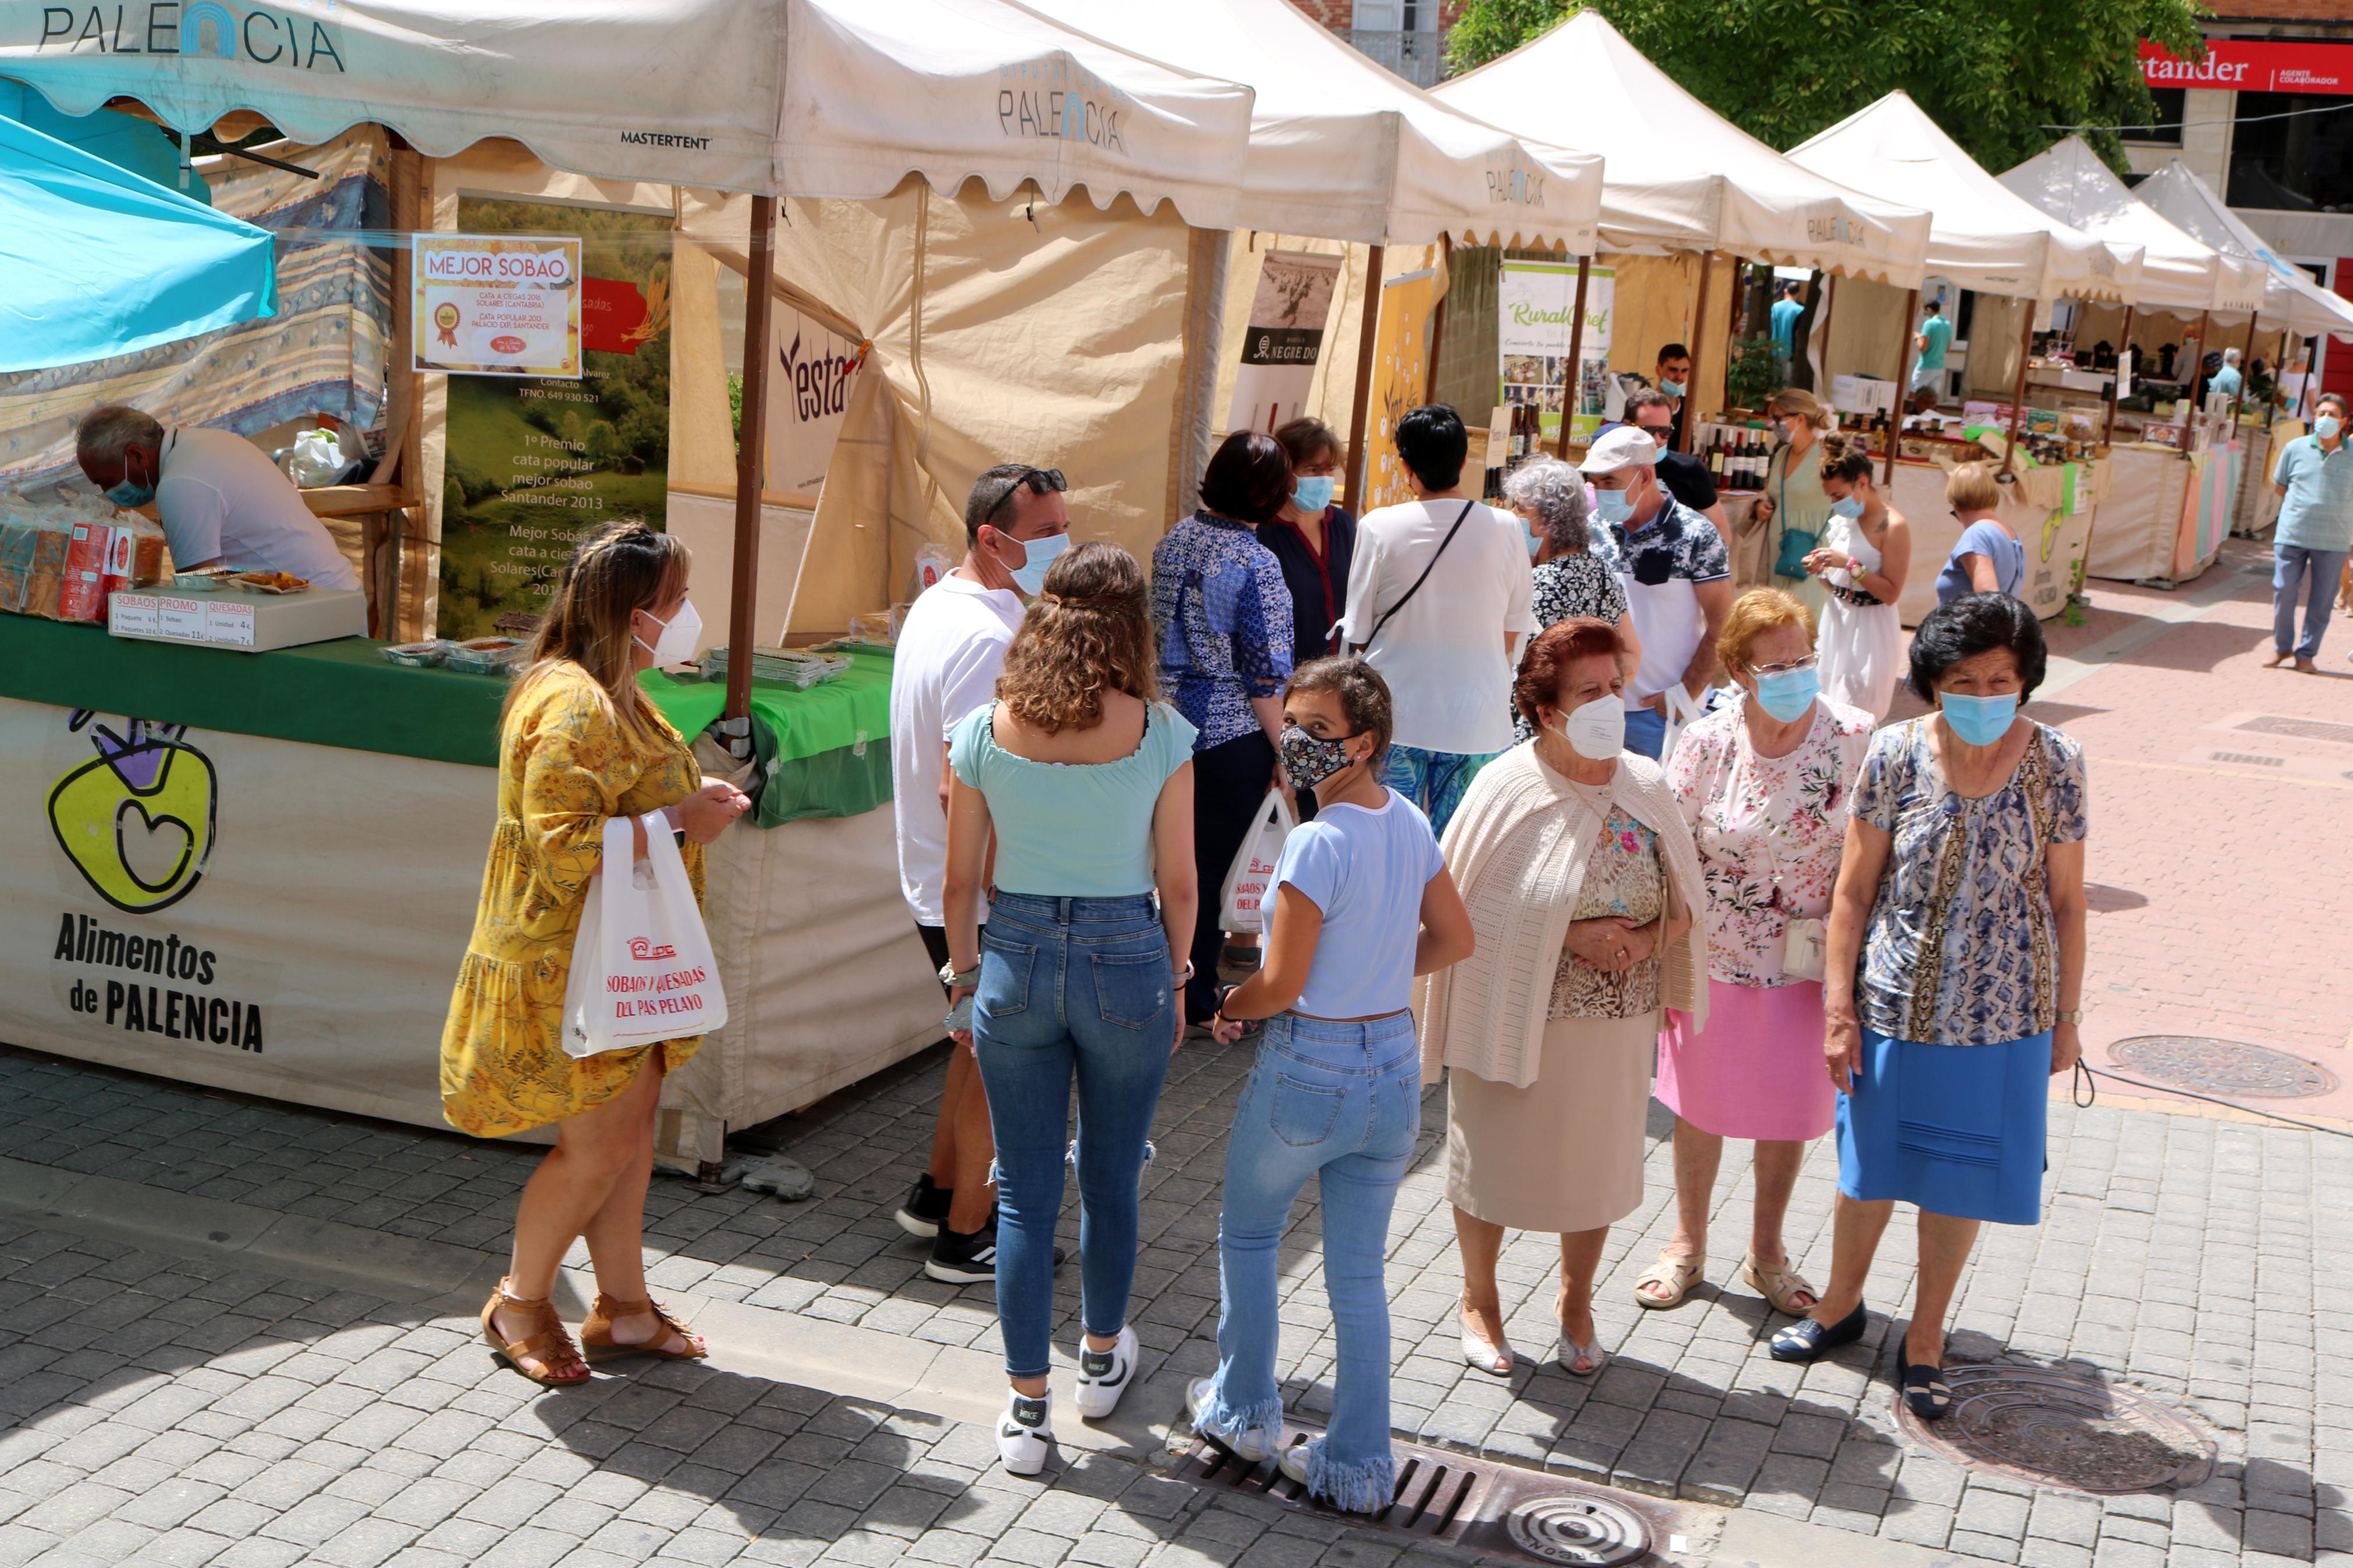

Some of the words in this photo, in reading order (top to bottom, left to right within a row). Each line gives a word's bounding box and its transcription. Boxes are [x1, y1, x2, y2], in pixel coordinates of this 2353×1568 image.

[2279, 76, 2338, 85] COLABORADOR
[999, 90, 1122, 151] PALENCIA
[621, 131, 710, 150] MASTERTENT
[430, 256, 492, 276] MEJOR
[498, 258, 565, 278] SOBAO
[505, 300, 544, 309] (CANTABRIA)
[541, 378, 580, 389] Contacto
[519, 388, 546, 399] TFNO.
[547, 390, 563, 400] 649
[565, 392, 581, 401] 930
[583, 394, 599, 403] 521
[541, 435, 585, 451] Premio
[513, 455, 540, 465] cata
[544, 457, 595, 471] popular
[512, 474, 552, 488] mejor
[554, 476, 593, 490] sobao
[501, 489, 567, 507] Santander
[571, 496, 603, 510] 2013
[509, 525, 548, 541] Mejor
[509, 546, 536, 557] cata
[540, 549, 546, 557] a
[117, 595, 156, 608] SOBAOS
[159, 598, 198, 611] PROMO
[209, 603, 252, 614] QUESADAS
[121, 614, 142, 622] Paquete
[121, 625, 144, 634] Paquetes
[240, 621, 245, 629] 4
[165, 629, 190, 638] Quesadas
[215, 636, 239, 645] Unidades
[1237, 899, 1252, 910] DEL
[54, 913, 217, 985] Alimentos
[606, 976, 648, 993] SOBAOS
[616, 1001, 636, 1018] DEL
[637, 1000, 658, 1016] PAS
[658, 994, 703, 1015] PELAYO
[70, 979, 98, 1013] de
[107, 980, 262, 1053] PALENCIA
[1089, 1363, 1106, 1371] NIKE
[1019, 1409, 1038, 1420] NIKE
